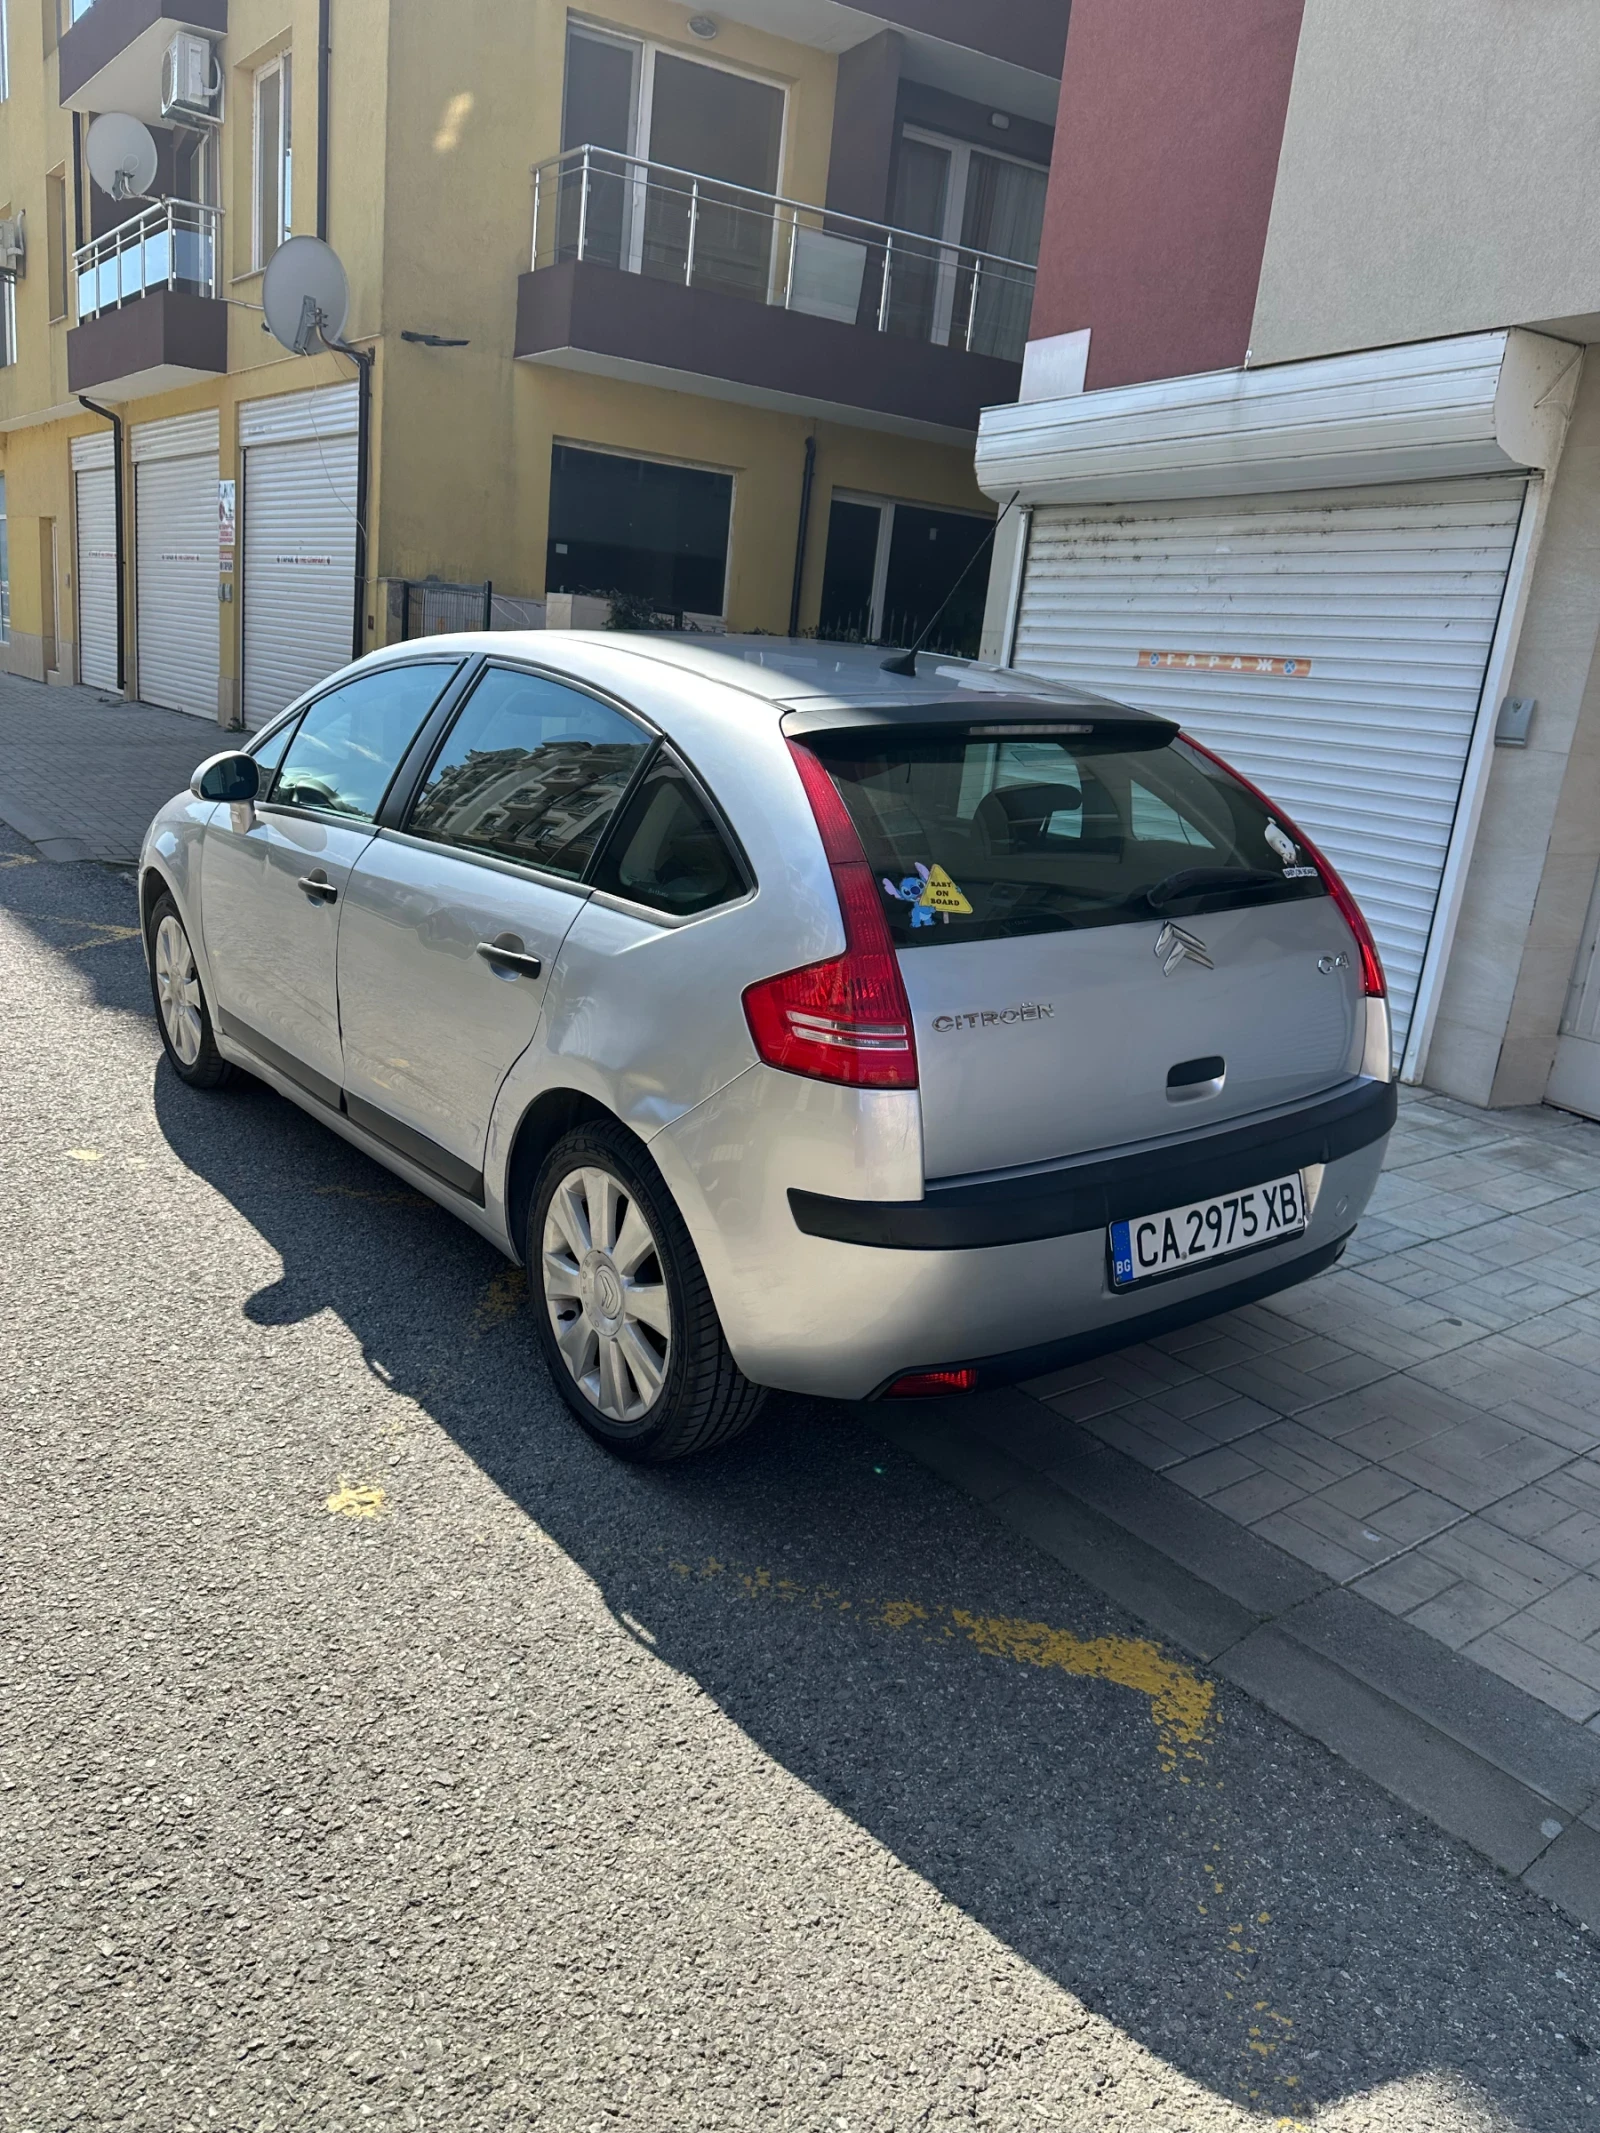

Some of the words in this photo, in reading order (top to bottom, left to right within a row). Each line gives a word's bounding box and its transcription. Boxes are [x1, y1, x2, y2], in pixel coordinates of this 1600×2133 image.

[1166, 654, 1273, 672] ГАРАЖ
[930, 898, 960, 906] BOARD
[1317, 951, 1350, 975] C4
[931, 1001, 1055, 1033] CITROËN
[1116, 1259, 1131, 1275] BG
